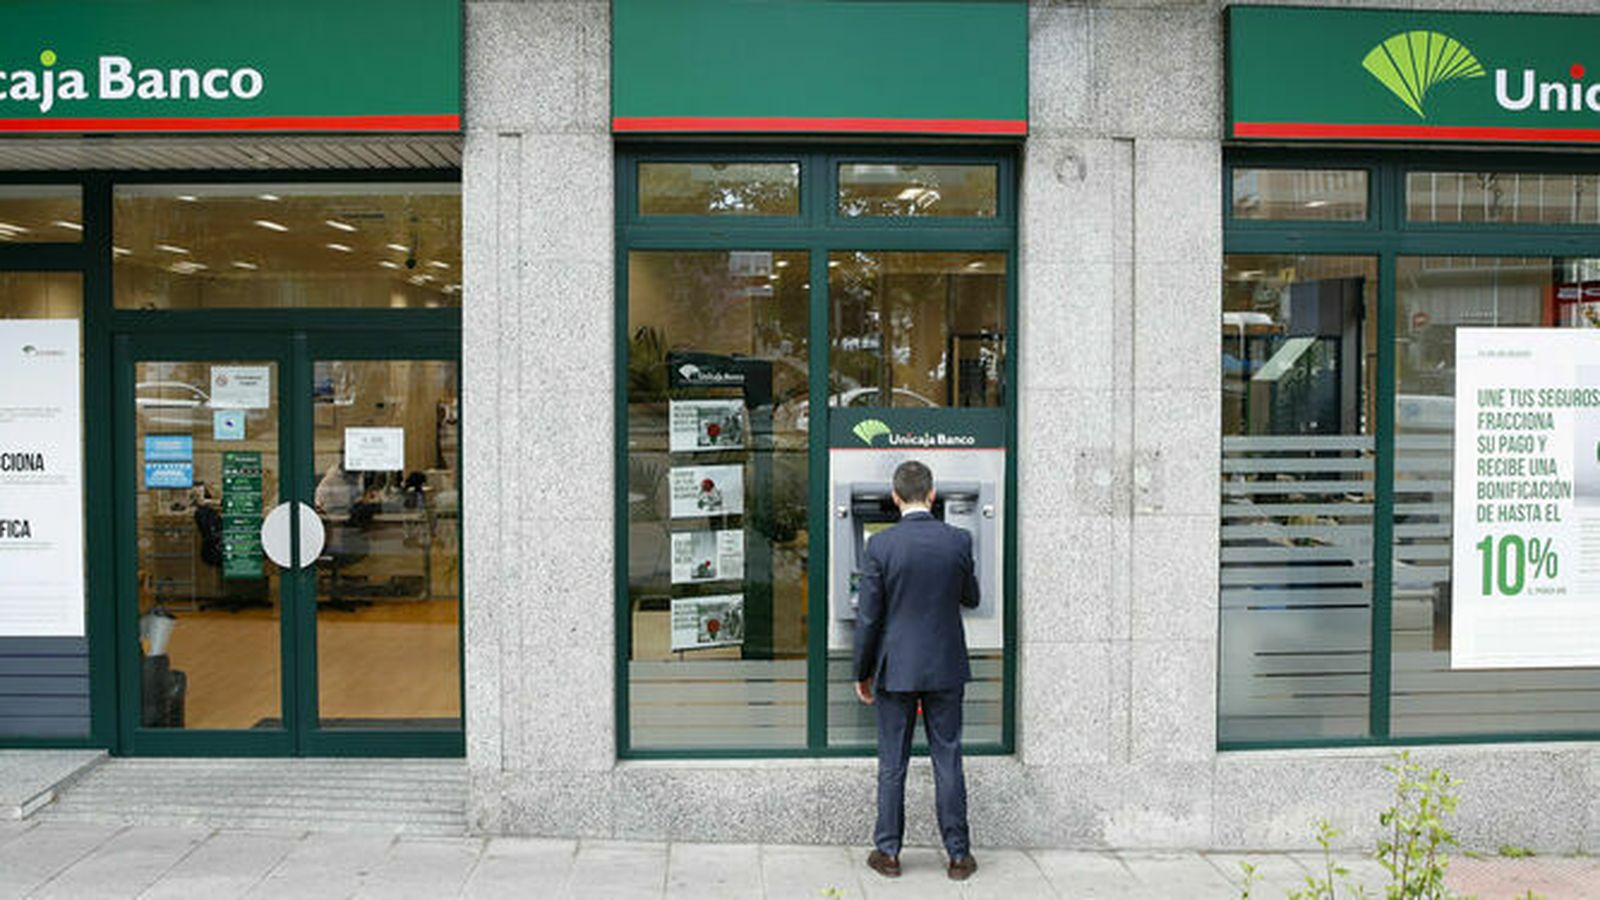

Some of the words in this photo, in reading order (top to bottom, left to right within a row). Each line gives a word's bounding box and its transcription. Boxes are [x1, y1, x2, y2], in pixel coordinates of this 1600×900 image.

[0, 50, 89, 113] aja
[99, 55, 263, 100] Banco
[1477, 388, 1505, 407] UNE
[1509, 388, 1536, 407] TUS
[1477, 412, 1555, 430] FRACCIONA
[889, 432, 935, 447] Unicaja
[937, 434, 975, 445] Banco
[1477, 435, 1495, 454] SU
[1499, 435, 1535, 454] PAGO
[1537, 435, 1548, 453] Y
[1477, 458, 1526, 477] RECIBE
[1529, 458, 1558, 477] UNA
[1477, 504, 1494, 523] DE
[1498, 504, 1542, 523] HASTA
[1545, 504, 1562, 522] EL
[1476, 534, 1558, 596] 10%
